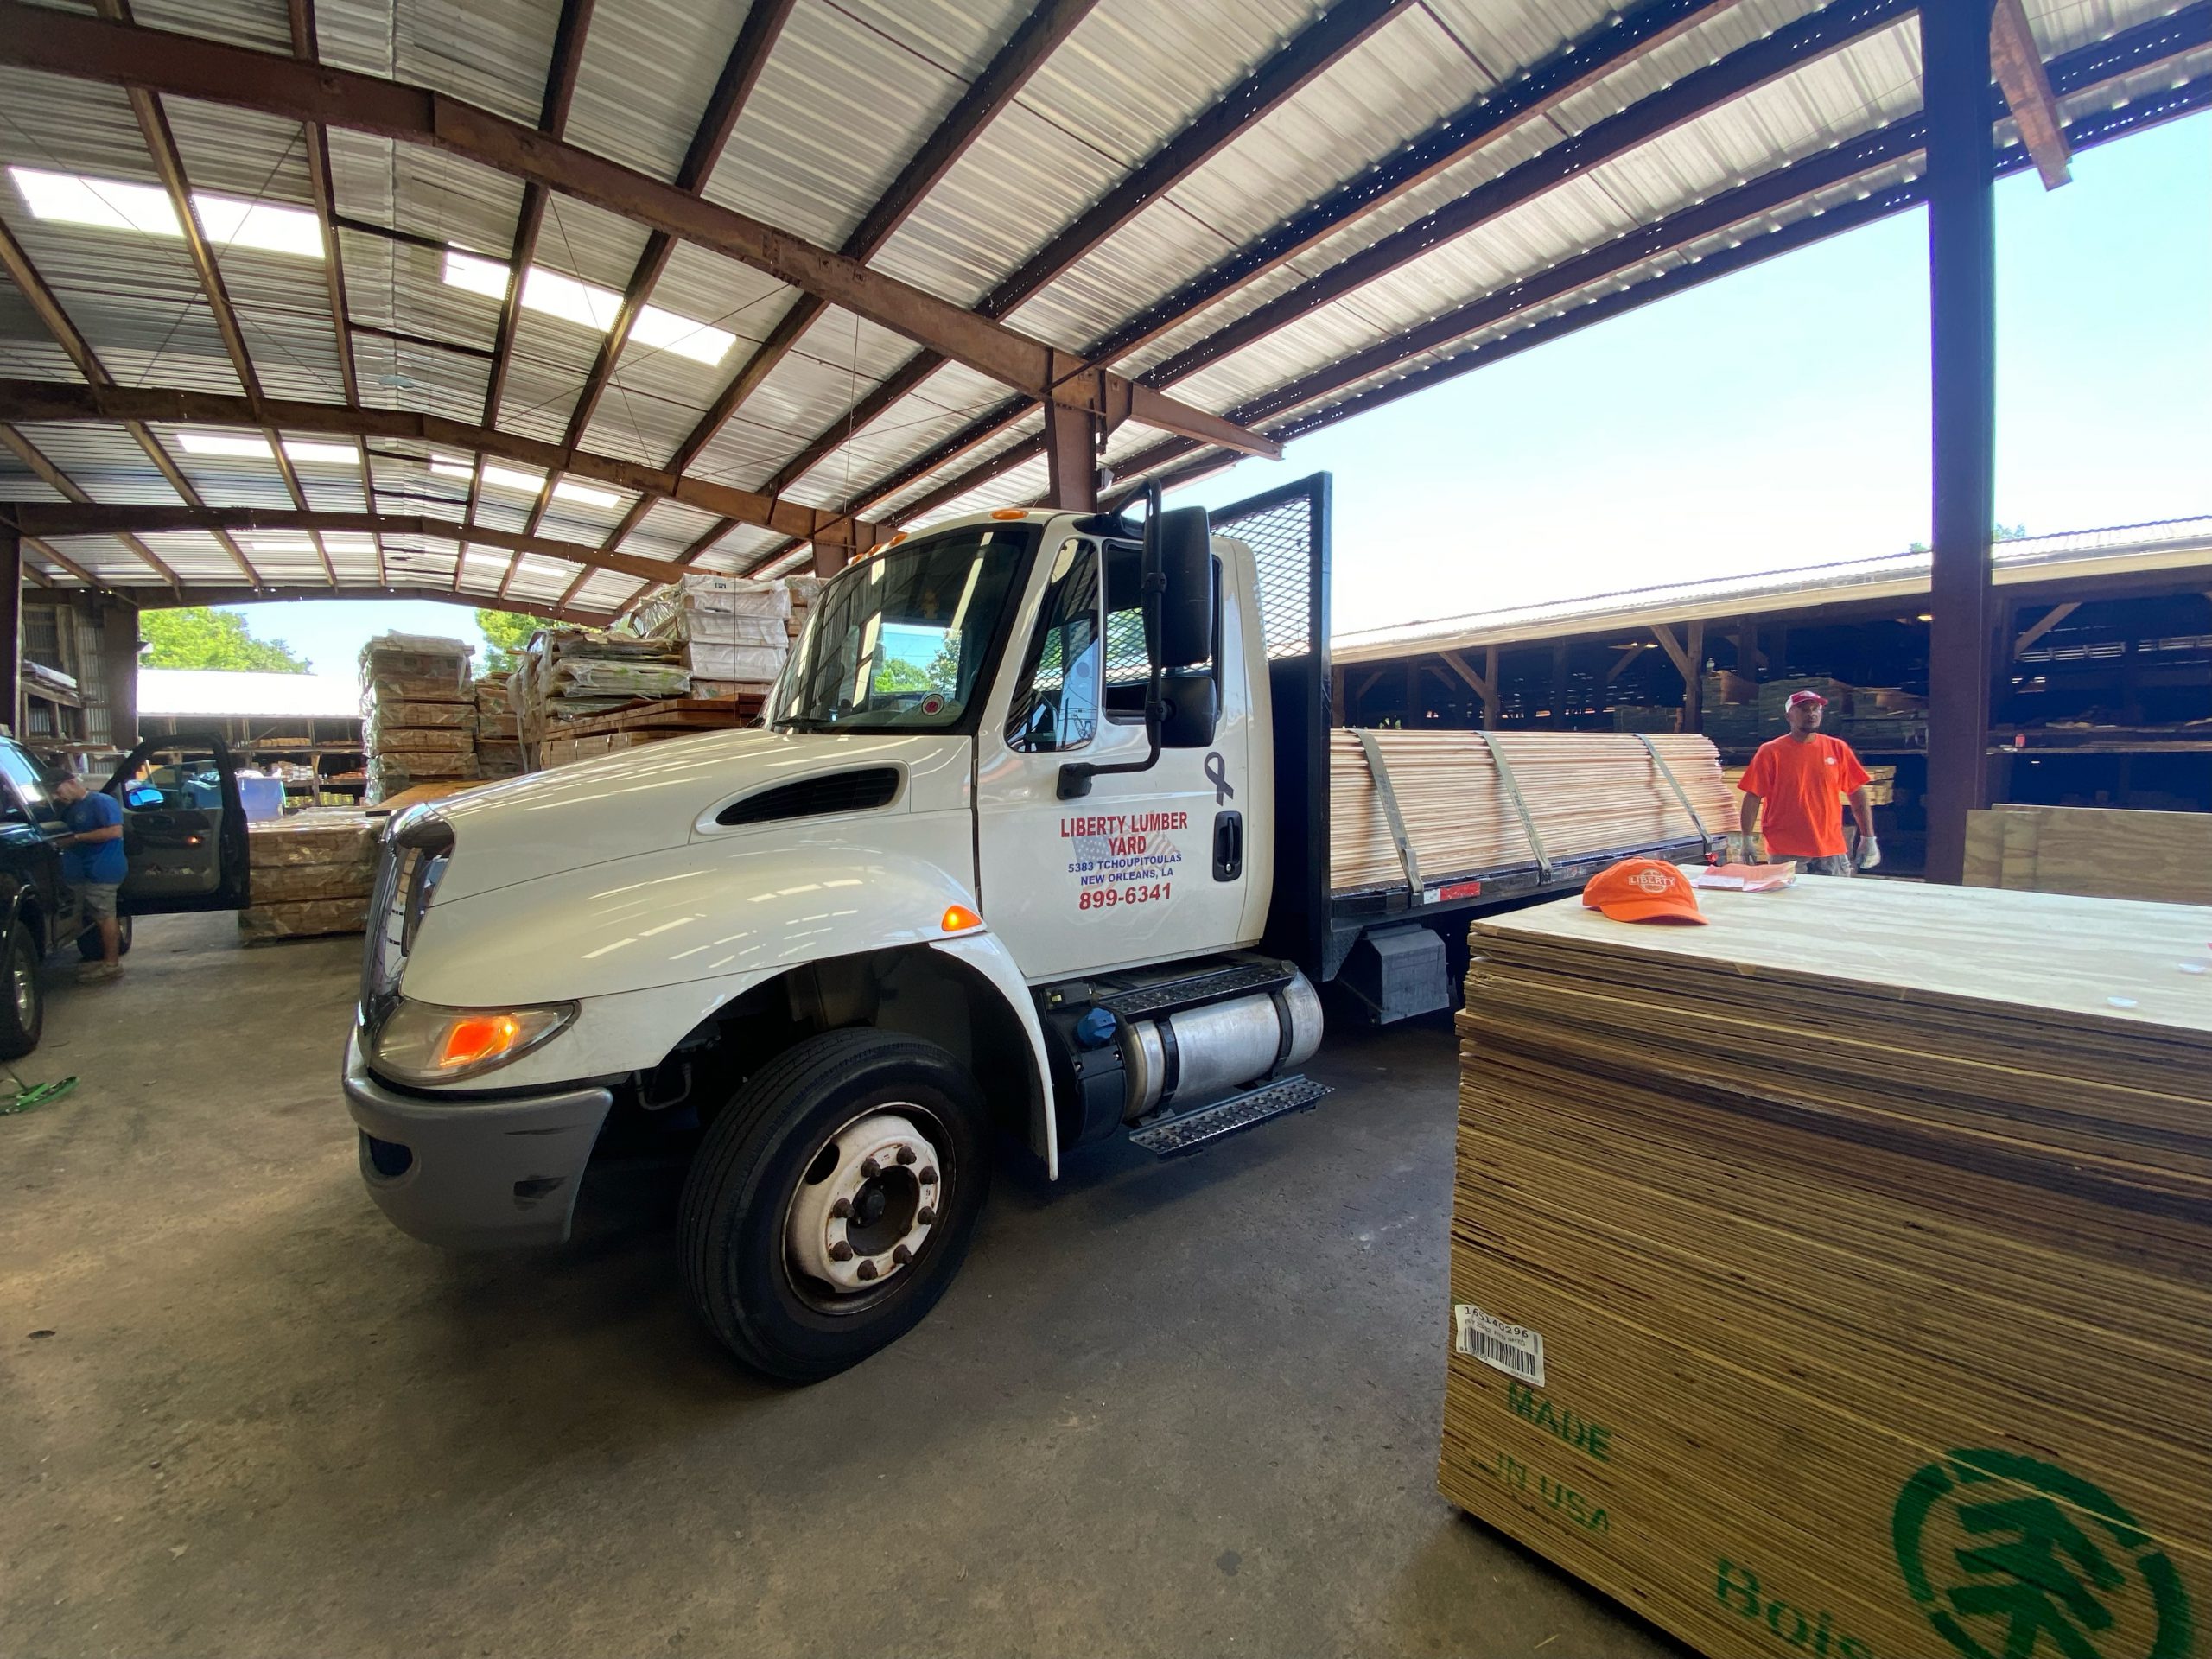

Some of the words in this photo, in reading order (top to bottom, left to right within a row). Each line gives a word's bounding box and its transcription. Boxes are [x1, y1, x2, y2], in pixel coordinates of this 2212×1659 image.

[1060, 815, 1127, 838] LIBERTY
[1130, 811, 1188, 833] LUMBER
[1108, 836, 1147, 856] YARD
[1068, 861, 1094, 873] 5383
[1097, 854, 1182, 870] TCHOUPITOULAS
[1080, 874, 1105, 886] NEW
[1108, 869, 1159, 883] ORLEANS,
[1161, 868, 1173, 877] LA
[1630, 875, 1675, 887] LIBERTY
[1078, 882, 1172, 911] 899-6341
[1465, 1306, 1529, 1338] 165140296
[1507, 1382, 1613, 1463] MADE
[1497, 1452, 1528, 1491] IN
[1540, 1474, 1611, 1531] USA
